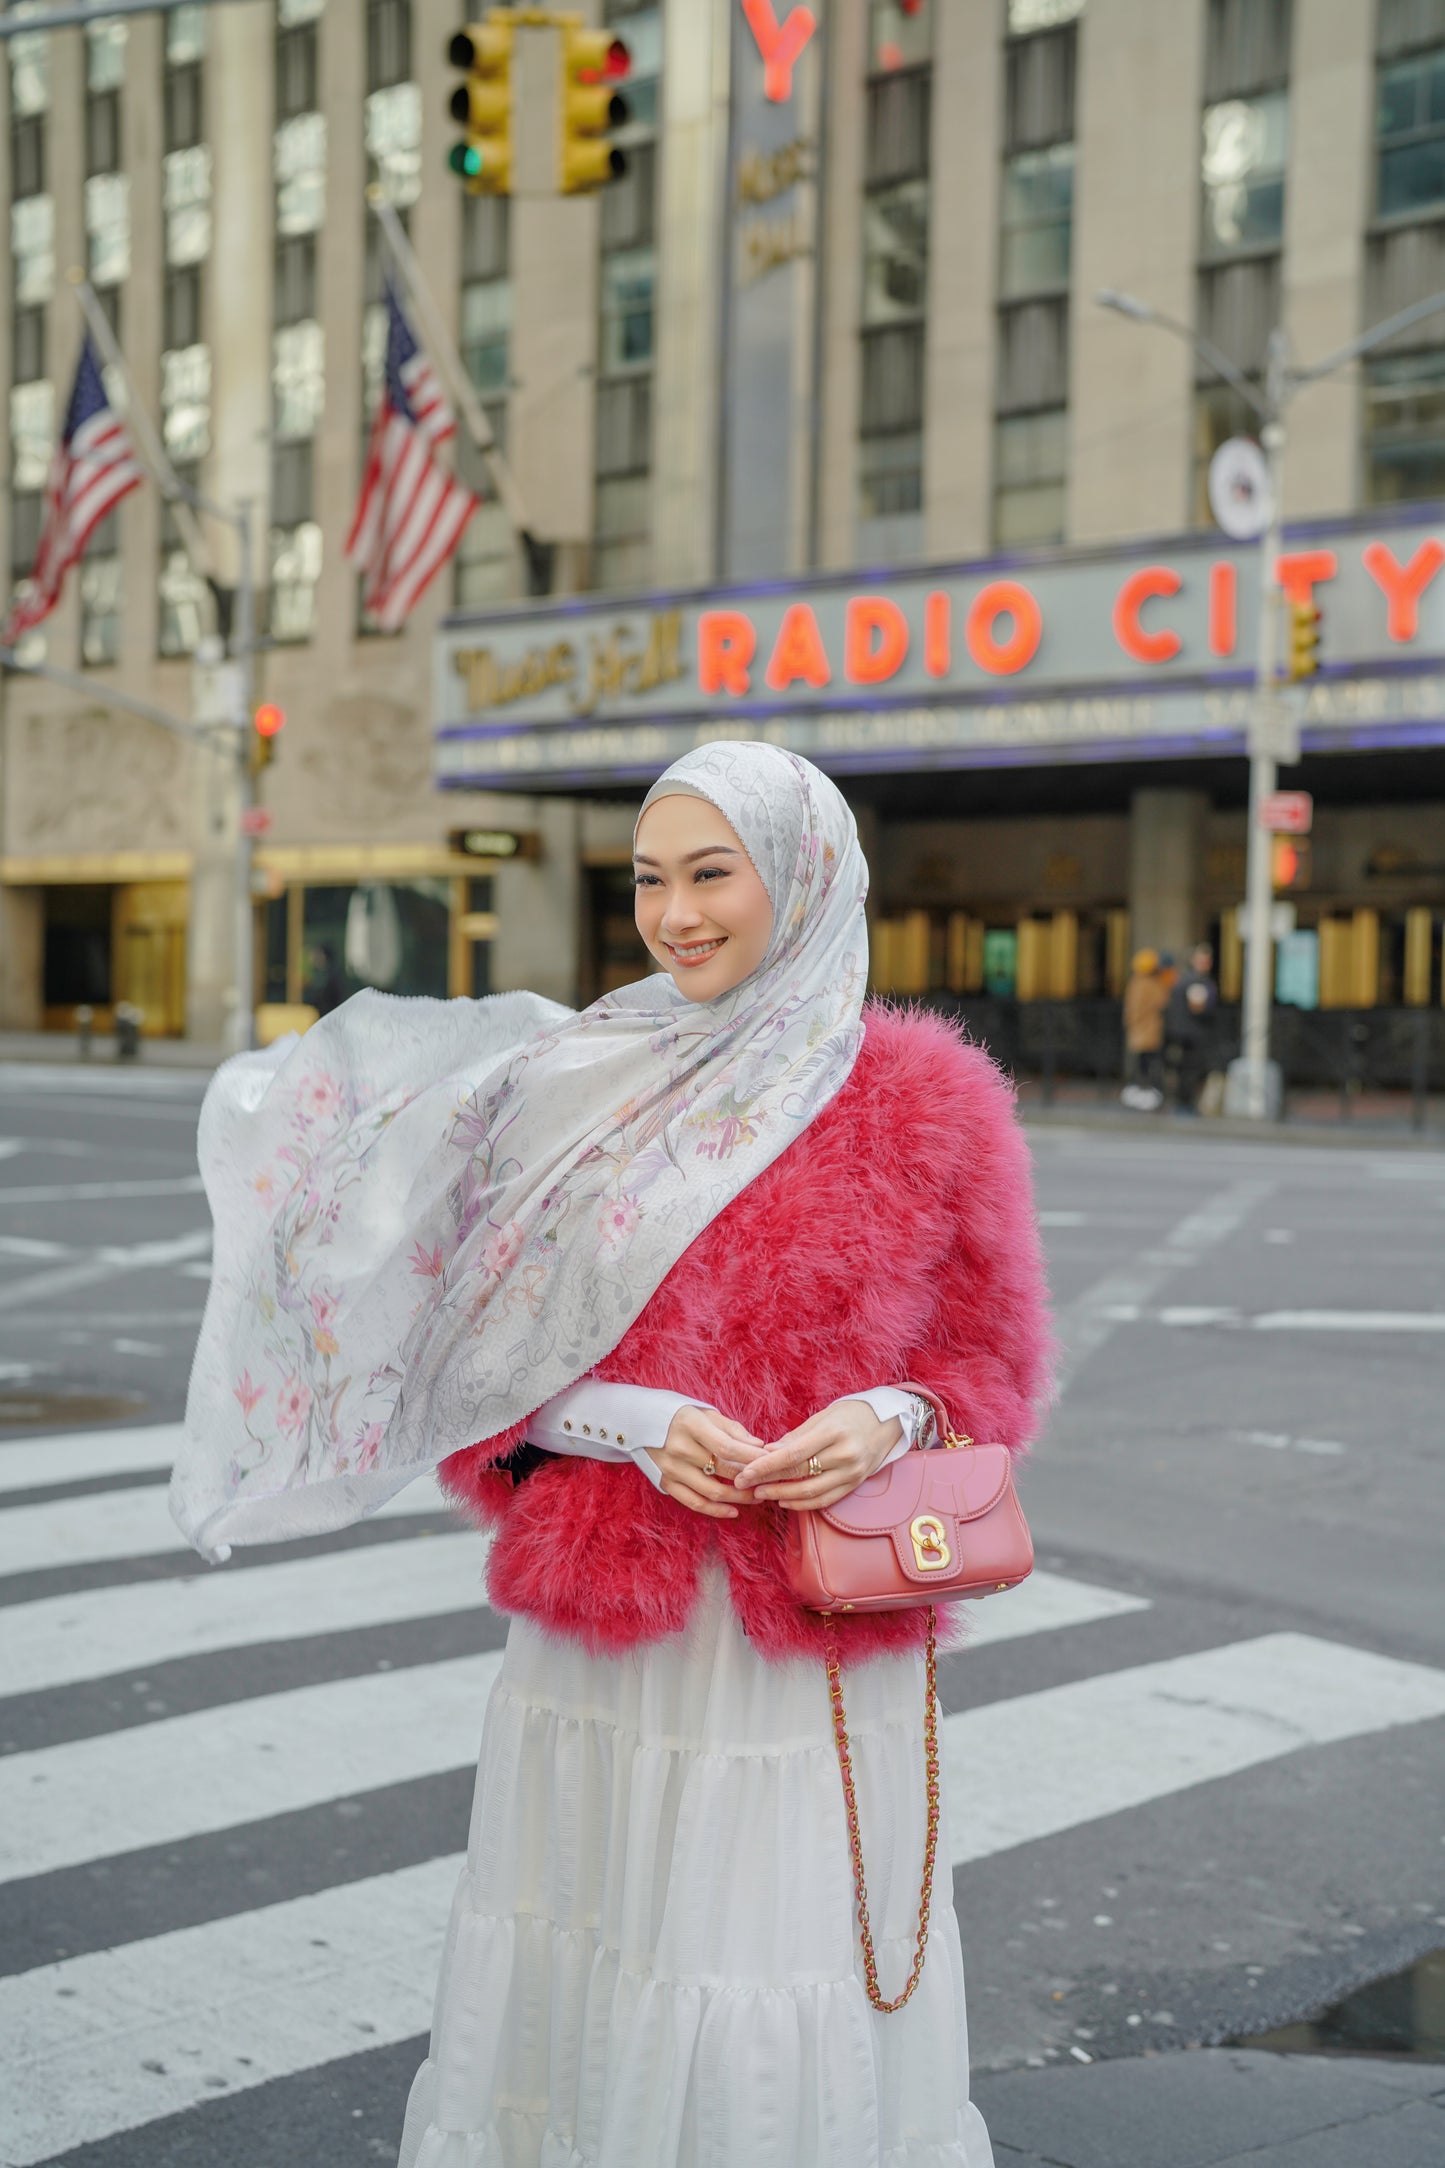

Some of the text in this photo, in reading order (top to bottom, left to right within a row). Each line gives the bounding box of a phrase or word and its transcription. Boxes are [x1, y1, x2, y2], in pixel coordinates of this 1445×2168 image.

[741, 0, 817, 104] Y
[697, 536, 1445, 697] RADIO CITY
